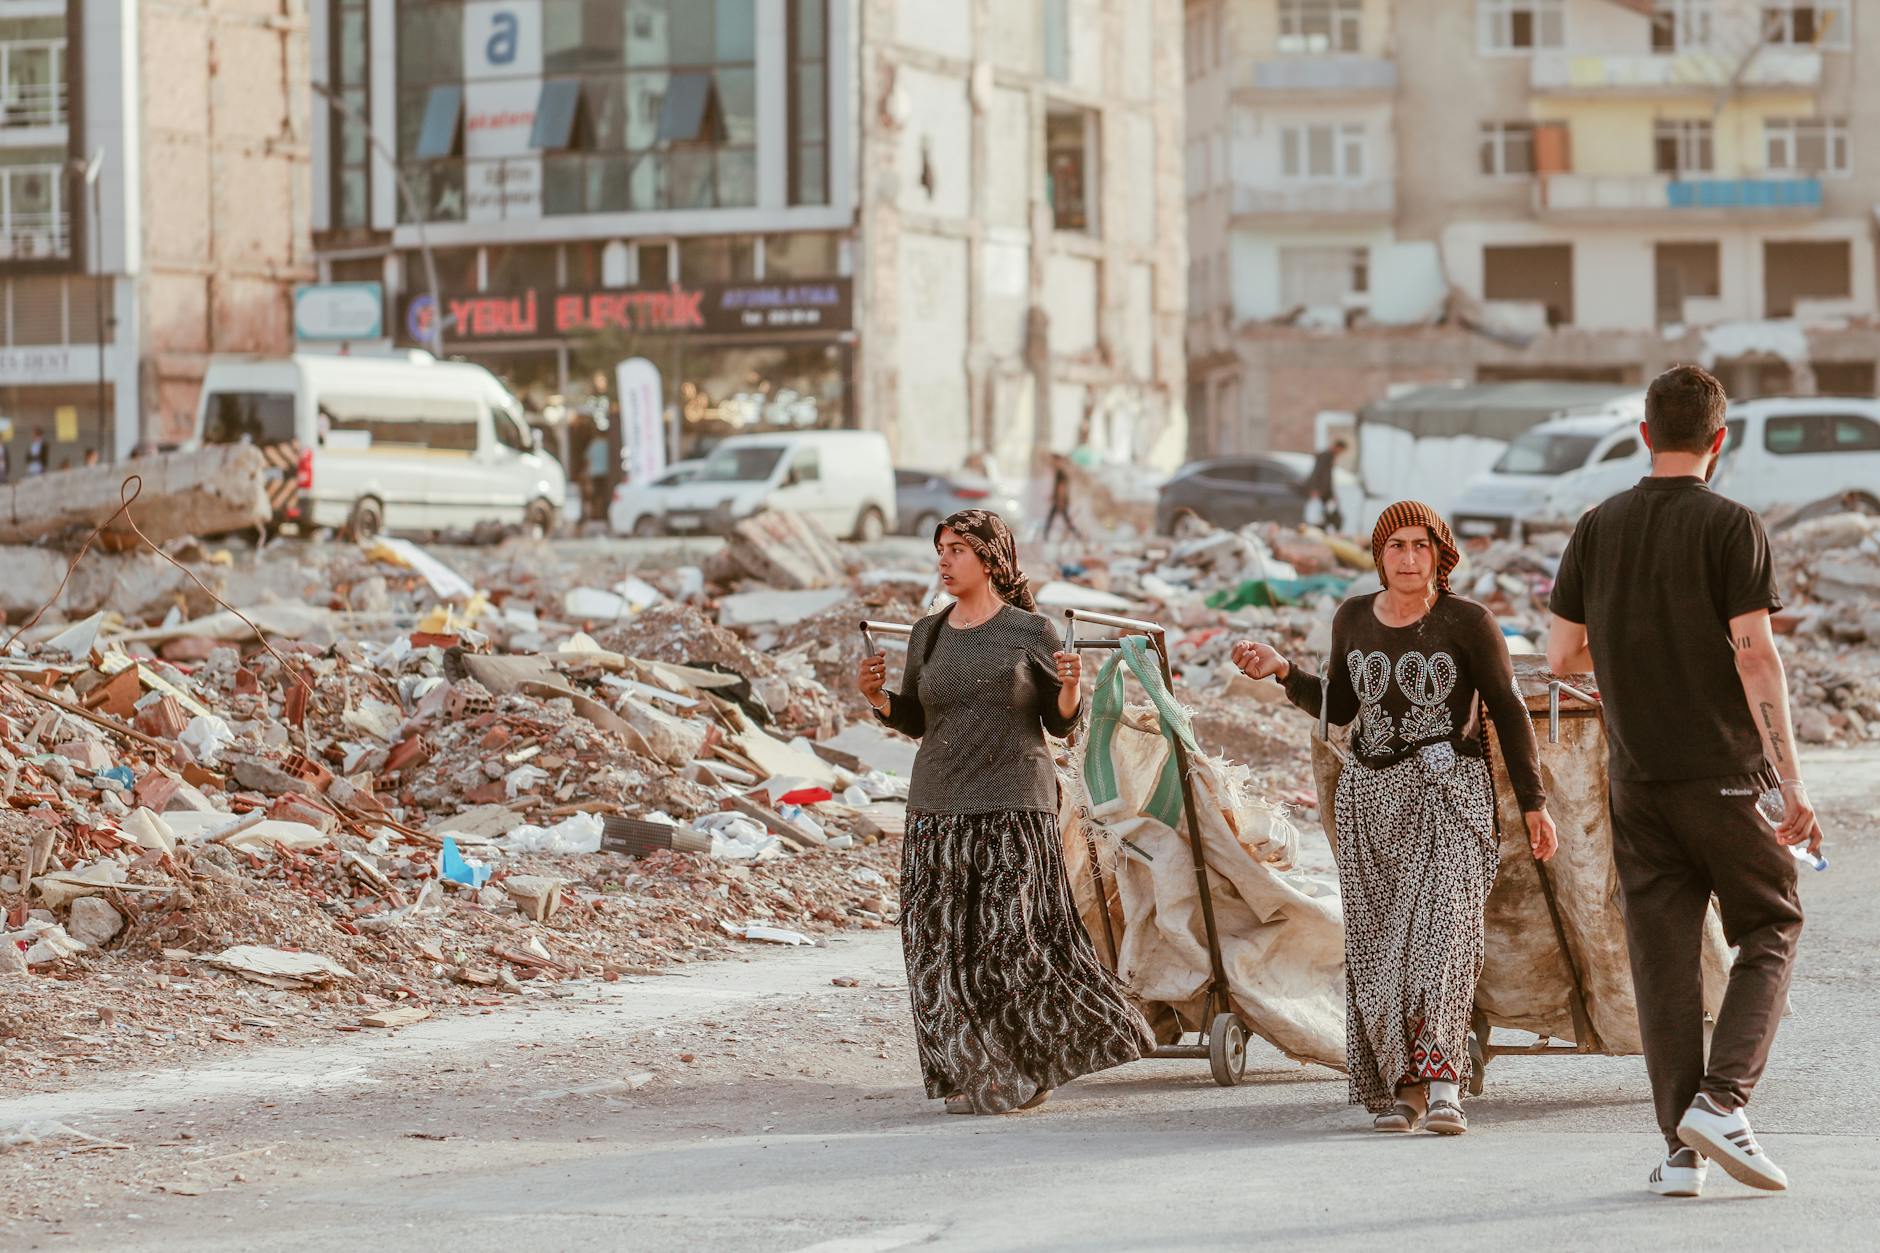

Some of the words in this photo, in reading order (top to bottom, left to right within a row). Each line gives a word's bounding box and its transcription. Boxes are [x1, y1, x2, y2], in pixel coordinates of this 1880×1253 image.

[486, 11, 518, 66] a
[449, 287, 537, 336] YERLİ
[555, 283, 704, 331] ELEKTRİK
